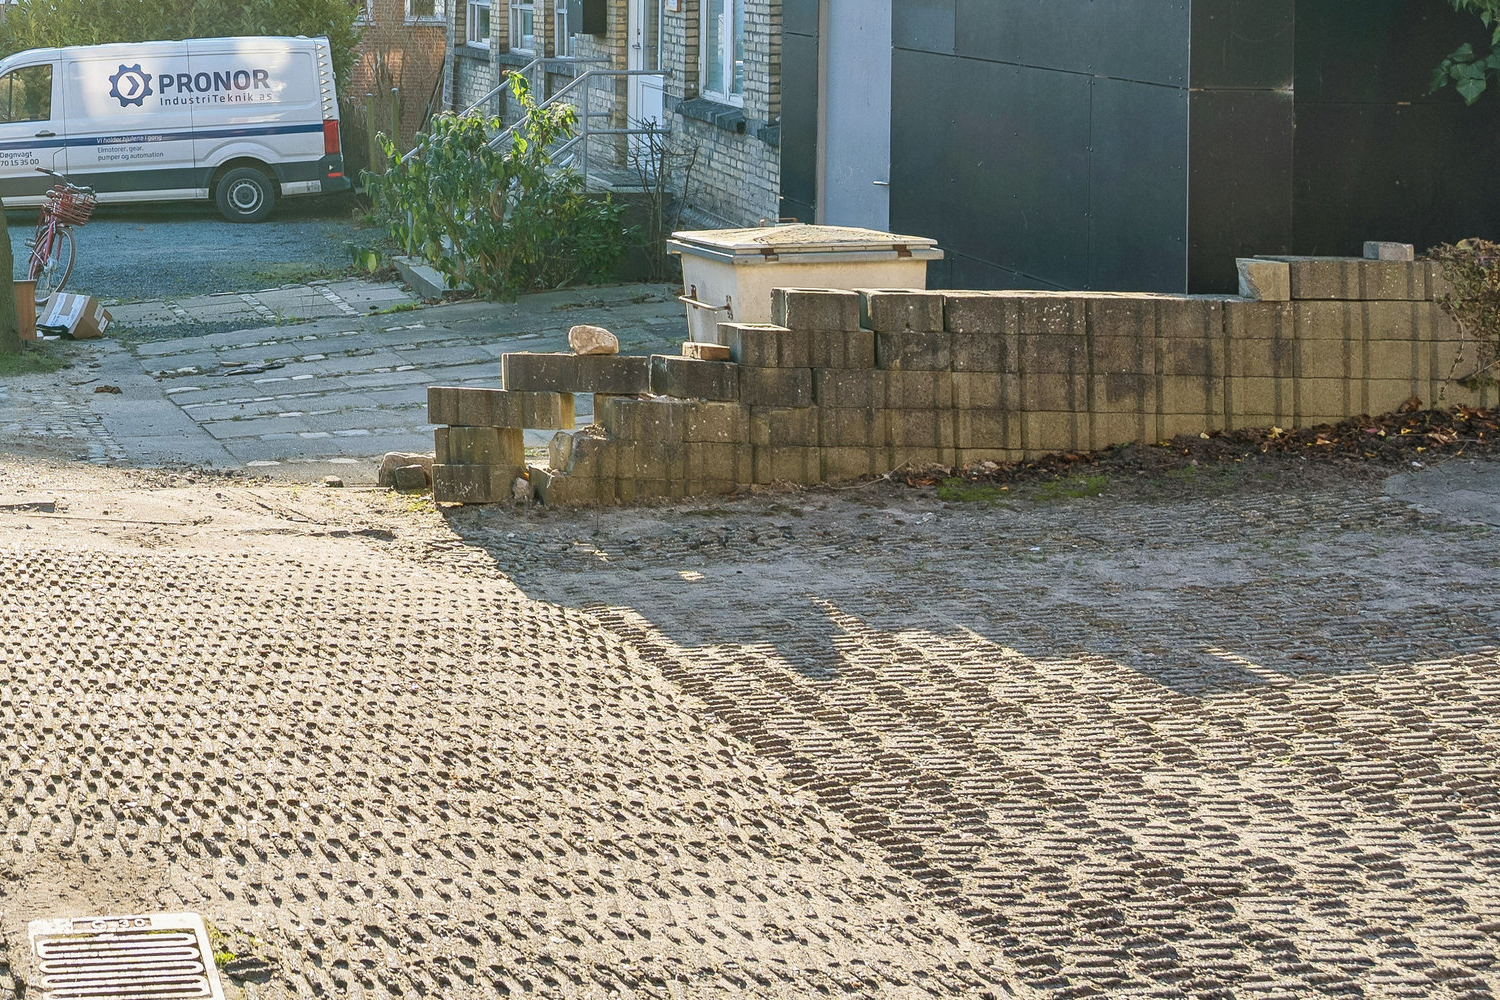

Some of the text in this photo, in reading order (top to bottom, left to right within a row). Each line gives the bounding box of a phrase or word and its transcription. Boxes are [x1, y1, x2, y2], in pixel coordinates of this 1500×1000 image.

[158, 69, 271, 94] PRONOR
[160, 92, 272, 106] IndustriTeknik as
[129, 145, 144, 153] gear,
[0, 151, 33, 159] Døgnvagt
[97, 154, 120, 162] pumper
